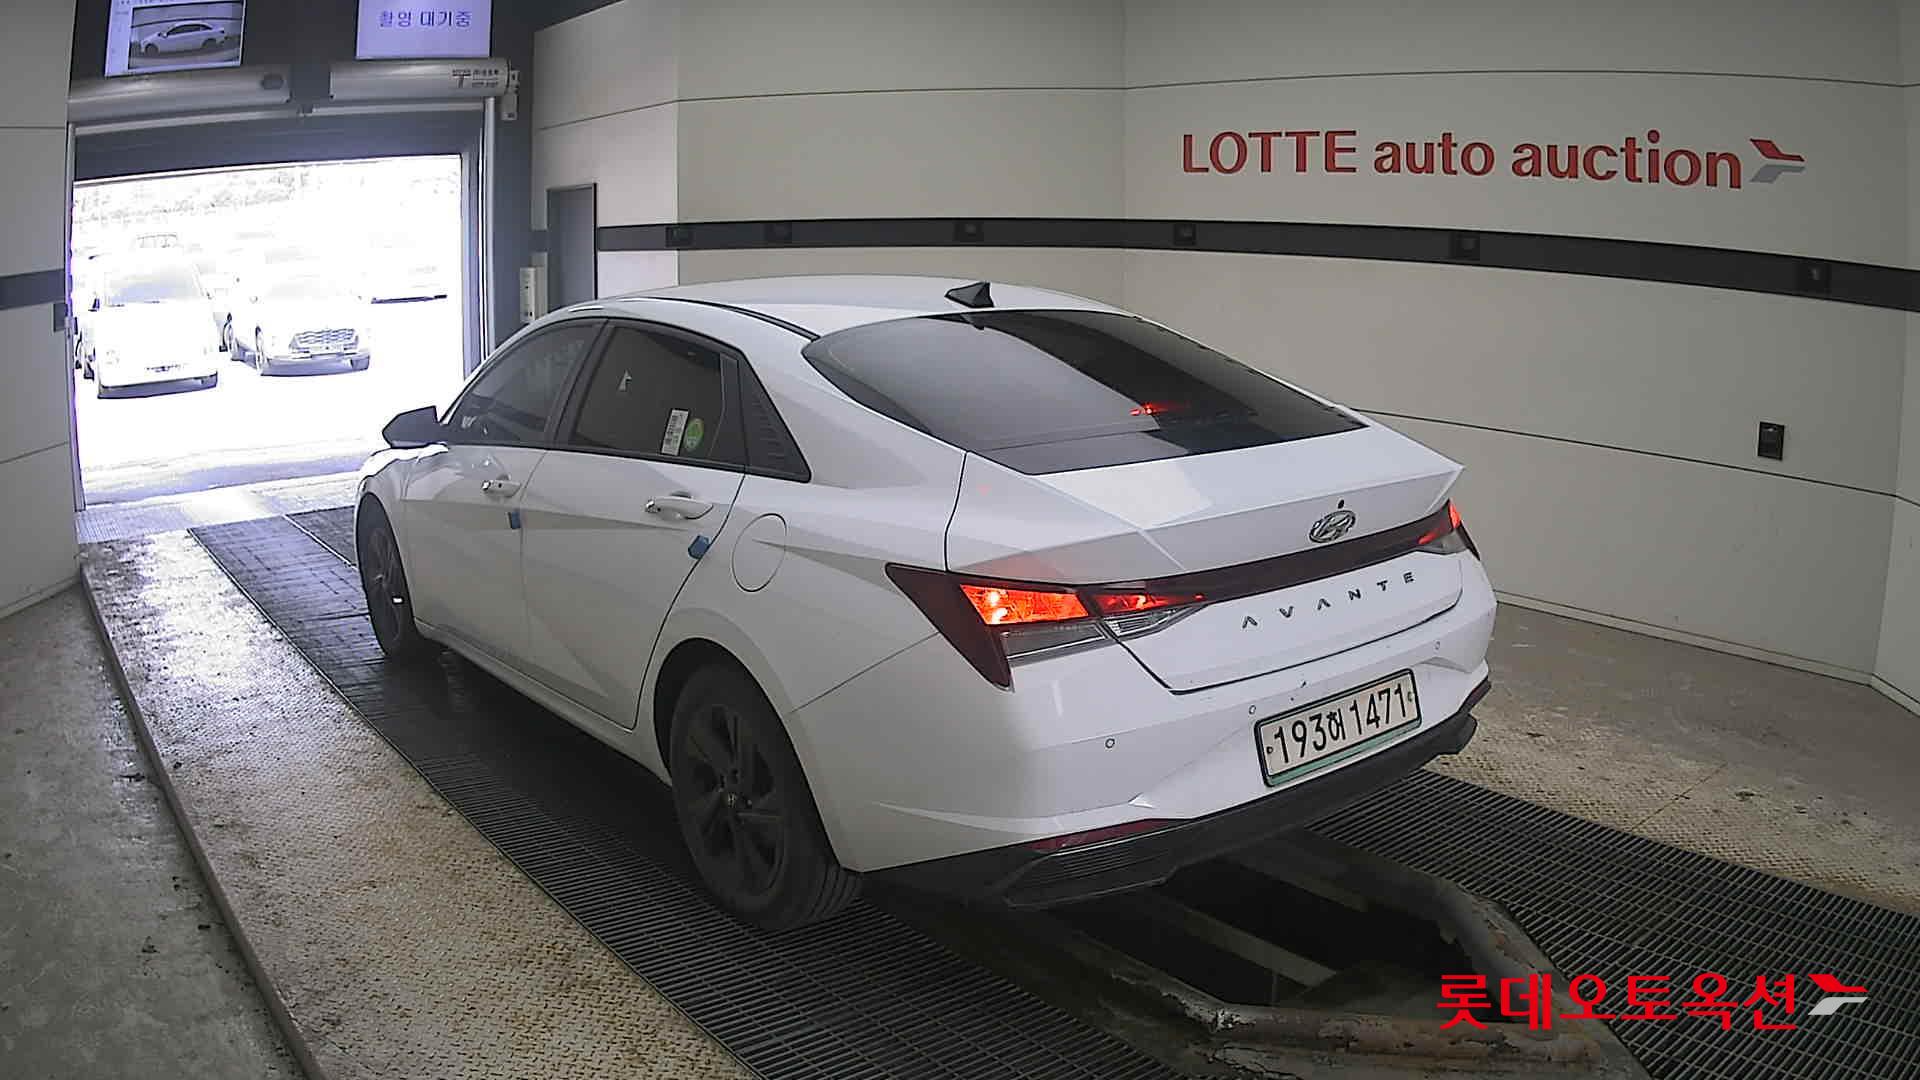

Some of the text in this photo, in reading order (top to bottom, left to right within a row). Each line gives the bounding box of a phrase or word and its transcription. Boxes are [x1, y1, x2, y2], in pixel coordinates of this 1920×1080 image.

[420, 10, 472, 28] 대기중
[1183, 129, 1743, 189] LOTTE auto auction
[1242, 571, 1416, 629] AVANTE
[1274, 683, 1407, 764] 193허 1471
